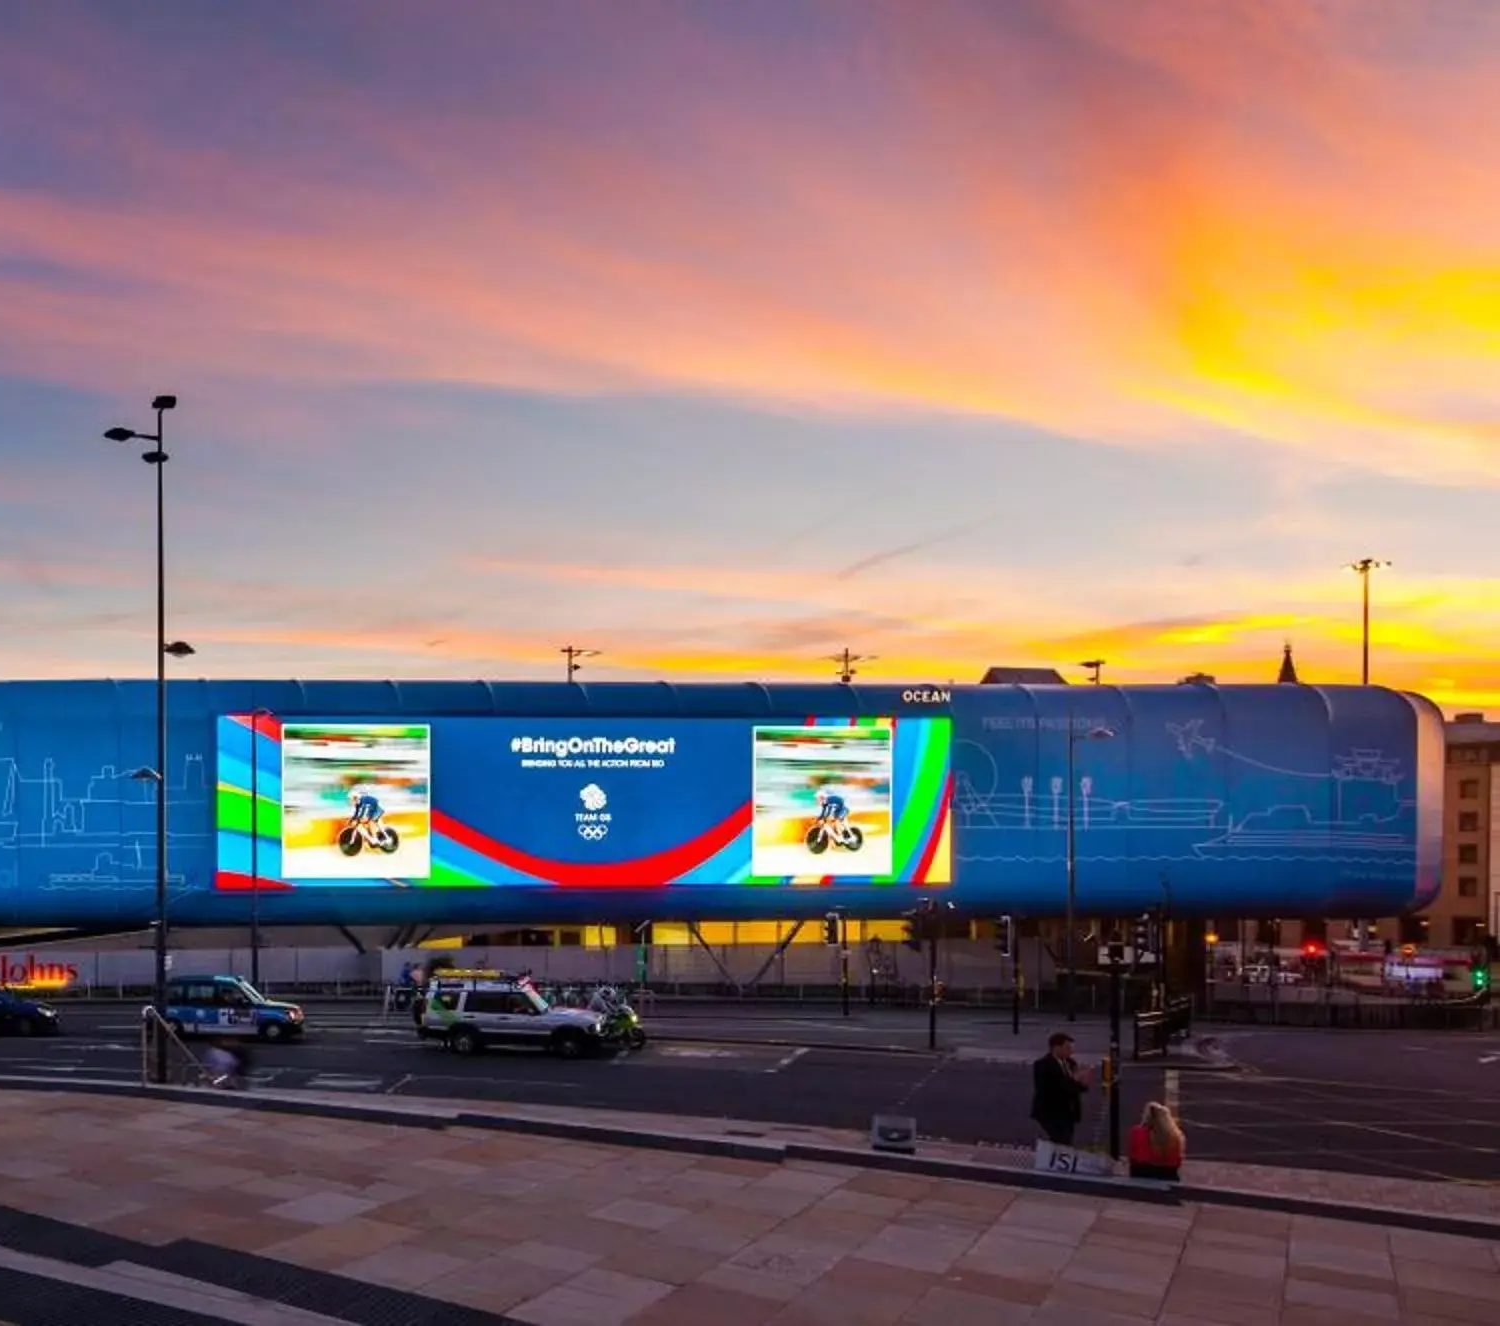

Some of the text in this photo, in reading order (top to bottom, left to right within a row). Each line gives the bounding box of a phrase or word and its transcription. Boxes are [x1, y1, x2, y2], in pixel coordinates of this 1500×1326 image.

[903, 690, 951, 702] OCEAN
[511, 736, 676, 758] #BringOnTheGreat
[575, 813, 612, 822] TEAM GB
